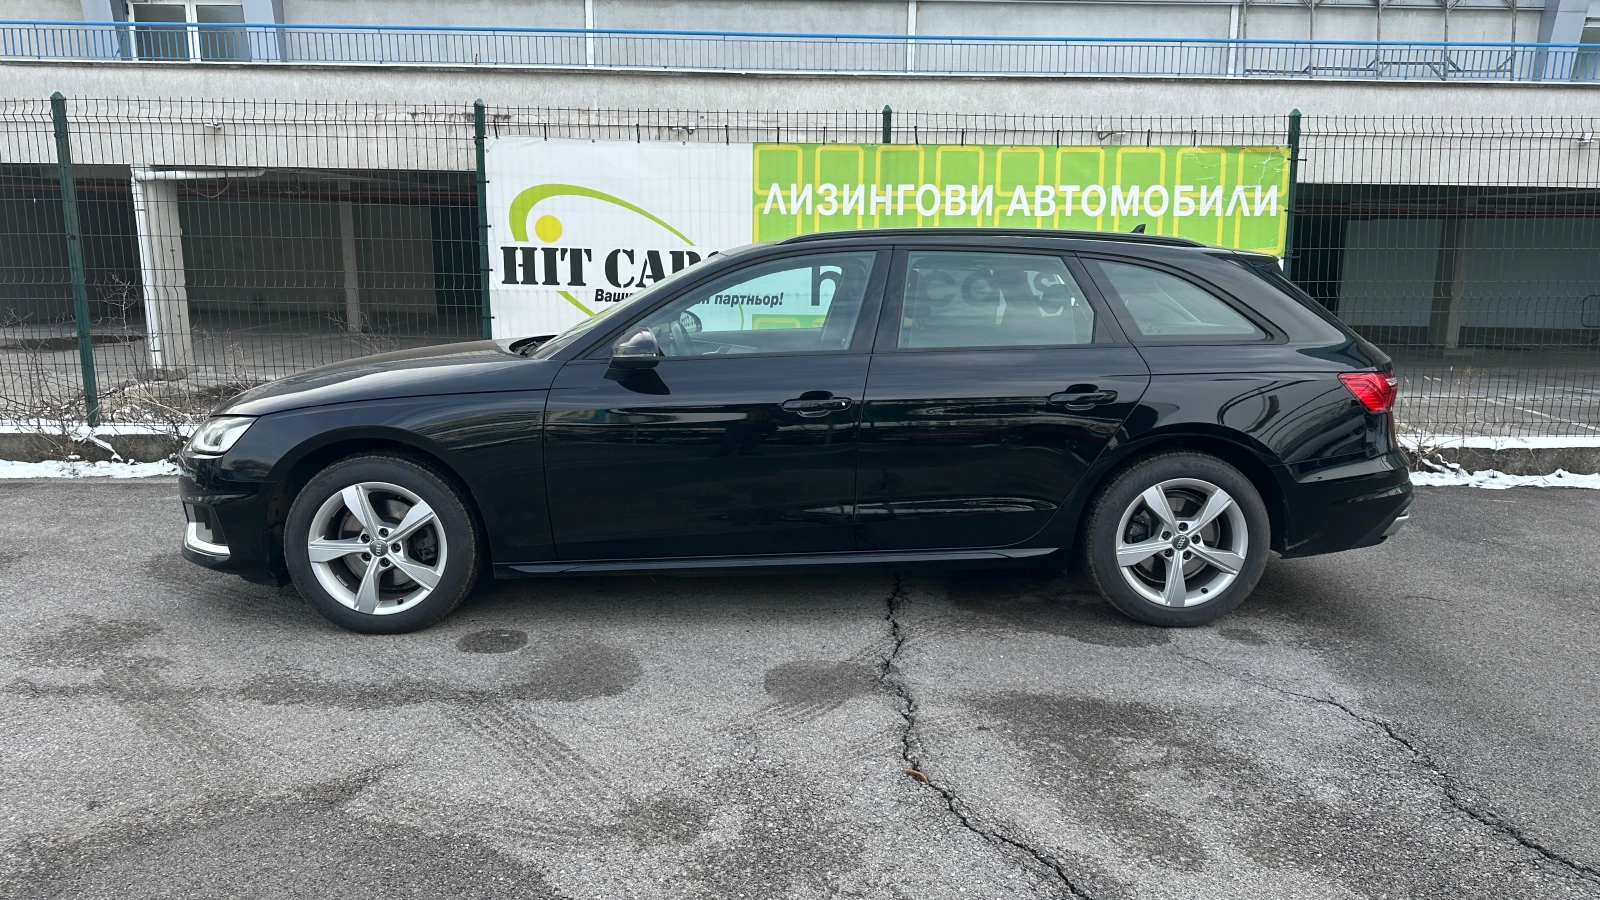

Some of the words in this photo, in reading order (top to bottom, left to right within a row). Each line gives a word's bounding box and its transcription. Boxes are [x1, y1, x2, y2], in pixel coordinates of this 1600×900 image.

[763, 182, 994, 217] ЛИЗИНГОВИ
[1006, 184, 1279, 218] АВТОМОБИЛИ
[500, 246, 592, 287] HIT
[604, 248, 719, 288] CA
[714, 292, 784, 308] партньор!
